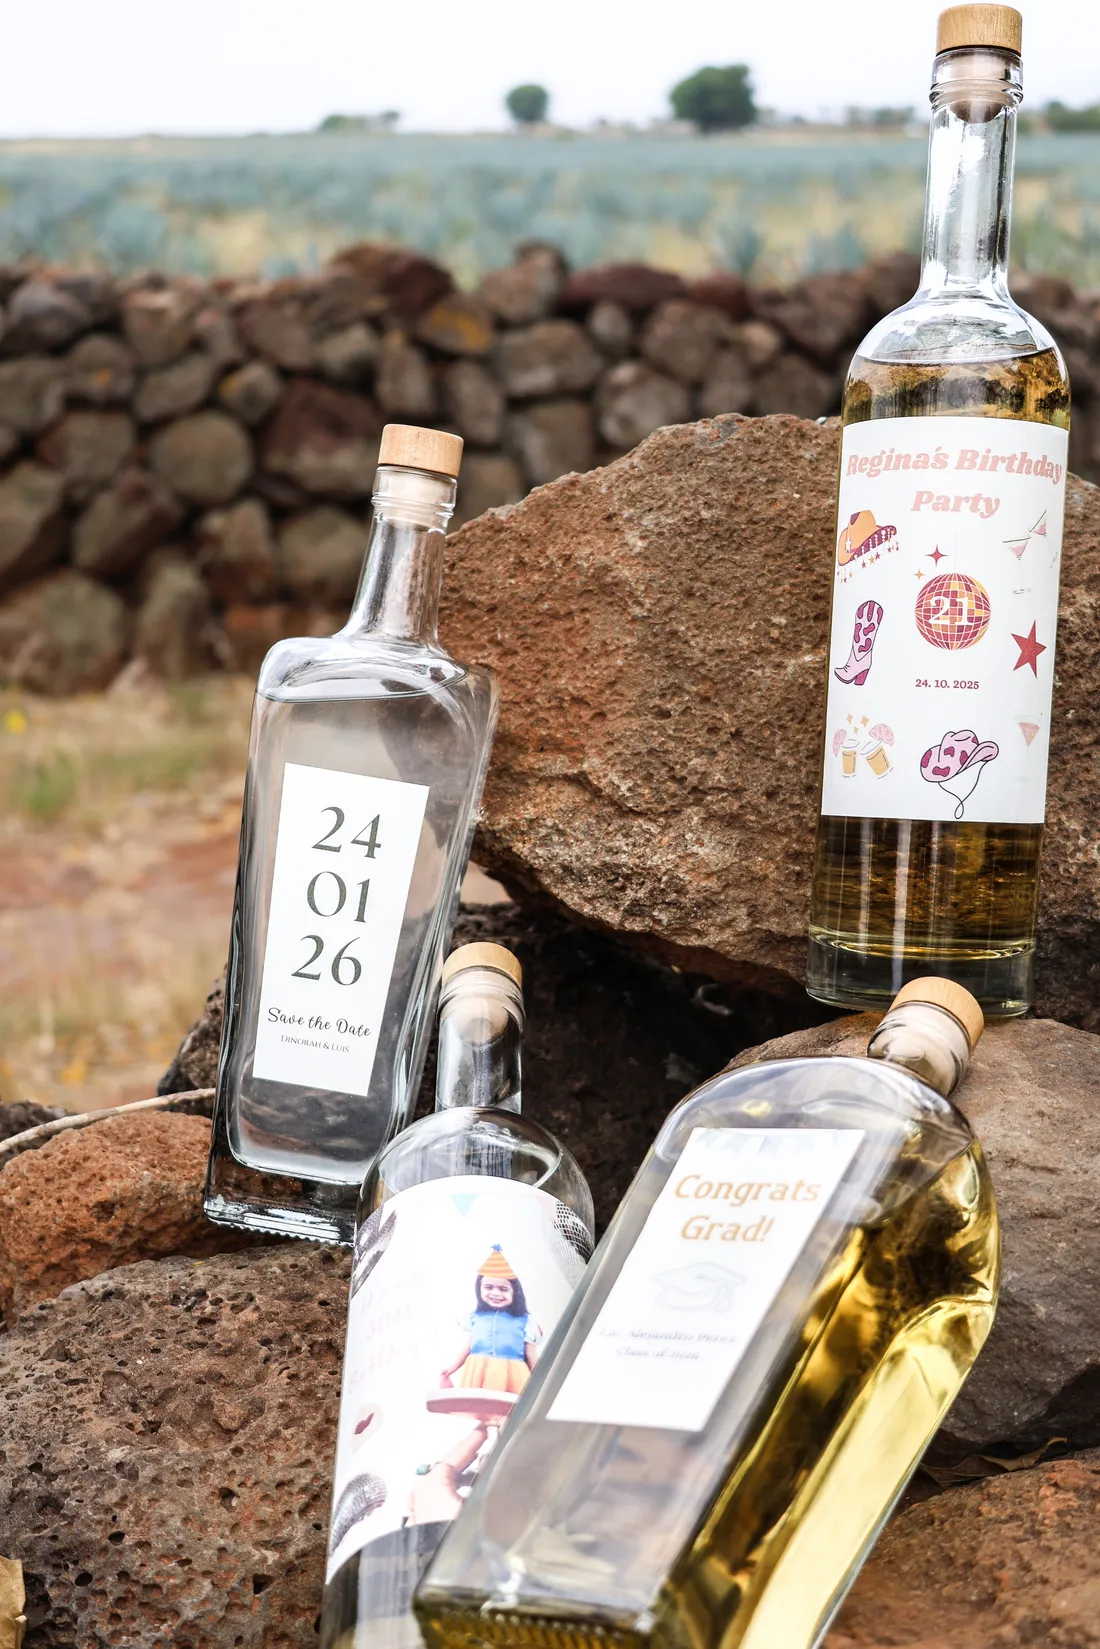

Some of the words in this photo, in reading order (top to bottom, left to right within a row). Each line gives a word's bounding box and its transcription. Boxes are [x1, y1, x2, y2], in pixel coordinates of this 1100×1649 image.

[954, 448, 1063, 485] Birthday
[910, 490, 1000, 519] Party
[928, 595, 974, 625] 21
[915, 678, 931, 688] 24.
[934, 679, 950, 688] 10.
[953, 680, 980, 690] 2025
[311, 806, 382, 859] 24
[306, 871, 371, 923] 01
[291, 934, 362, 986] 26
[267, 1007, 305, 1025] Save
[308, 1015, 331, 1030] the
[336, 1018, 371, 1037] Date
[280, 1034, 321, 1048] DINORAH
[322, 1042, 330, 1050] &
[331, 1043, 350, 1053] LUIS
[674, 1174, 821, 1207] Congrats
[680, 1215, 776, 1242] Grad!
